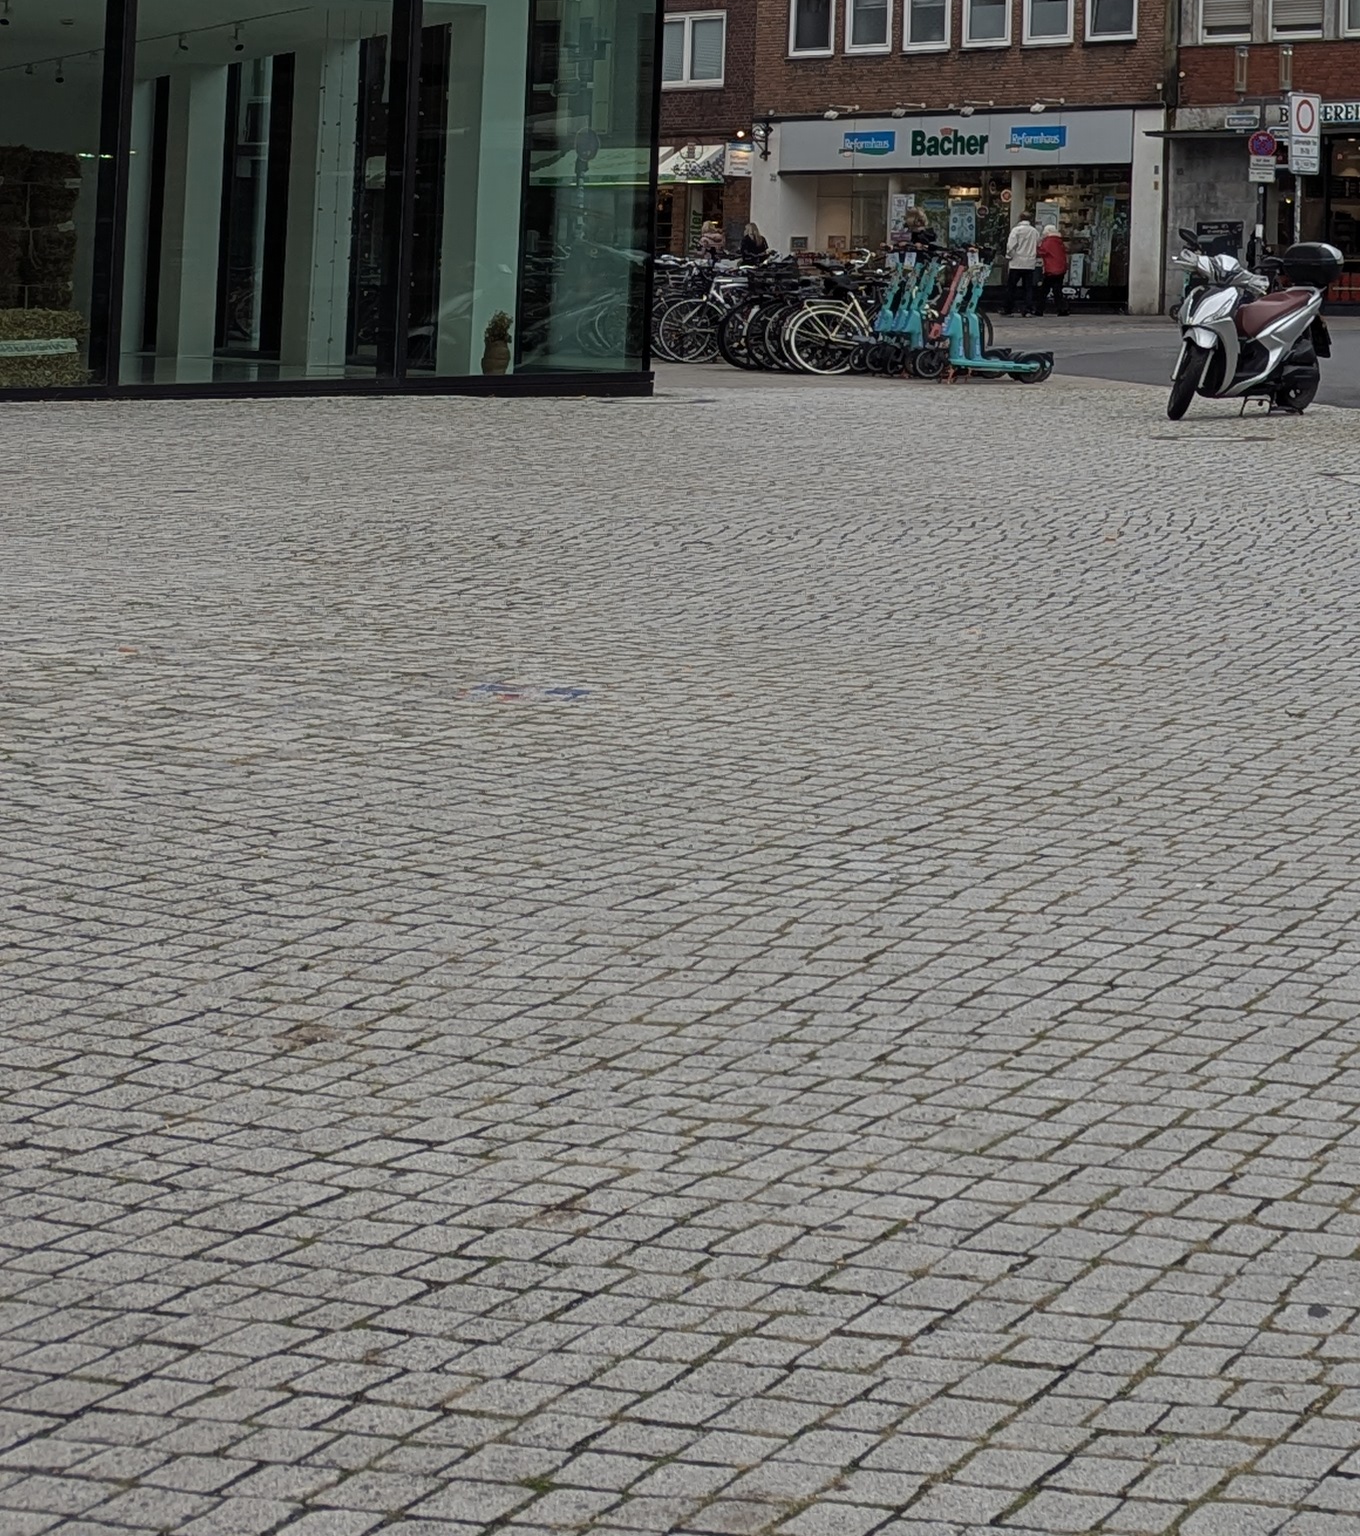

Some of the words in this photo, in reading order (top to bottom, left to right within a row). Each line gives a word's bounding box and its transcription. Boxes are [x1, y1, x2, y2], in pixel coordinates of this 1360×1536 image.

[845, 136, 890, 149] Reformhaus
[910, 129, 989, 156] Bacher
[1012, 131, 1060, 145] Reformhaus
